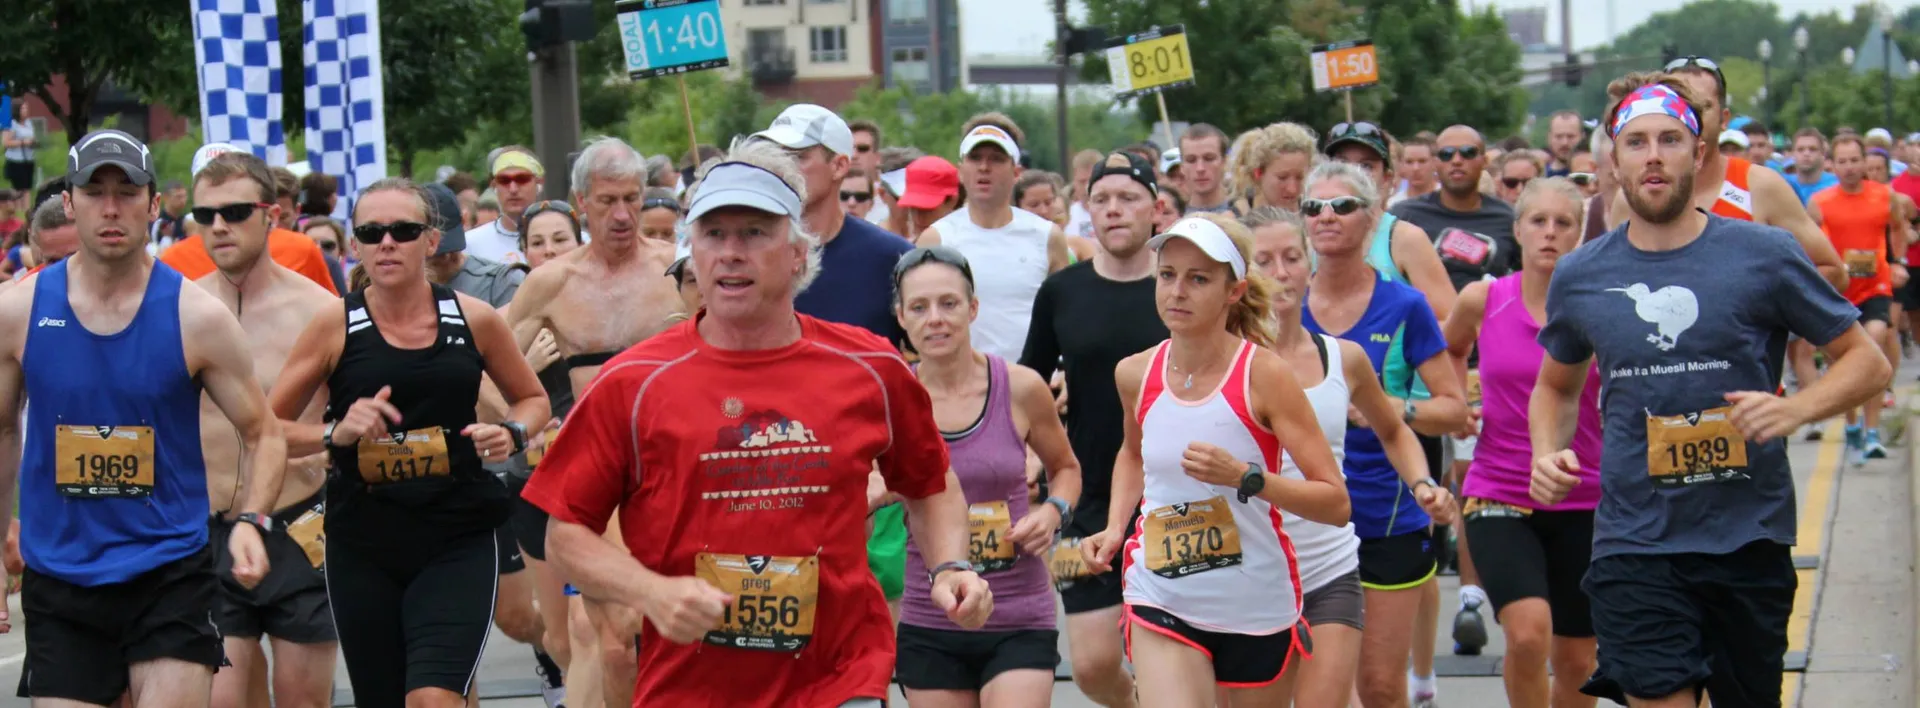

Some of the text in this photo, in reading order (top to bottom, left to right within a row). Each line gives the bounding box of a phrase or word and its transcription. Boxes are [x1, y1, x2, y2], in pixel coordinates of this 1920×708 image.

[623, 14, 644, 67] GOAL
[647, 11, 718, 53] 1:40
[1131, 42, 1184, 78] 8:01
[1329, 52, 1373, 78] 1:50
[1370, 333, 1390, 342] FILA
[1610, 368, 1632, 379] Make
[1641, 367, 1648, 376] a
[1650, 362, 1685, 375] Muesli
[1688, 360, 1731, 372] Morning.
[1667, 437, 1729, 468] 1939
[75, 454, 138, 478] 1969
[376, 456, 433, 480] 1417
[729, 497, 804, 511] June 10, 2012
[1165, 515, 1205, 531] Manuela
[1162, 526, 1223, 560] 1370
[742, 578, 771, 590] greg
[724, 594, 799, 628] 1556
